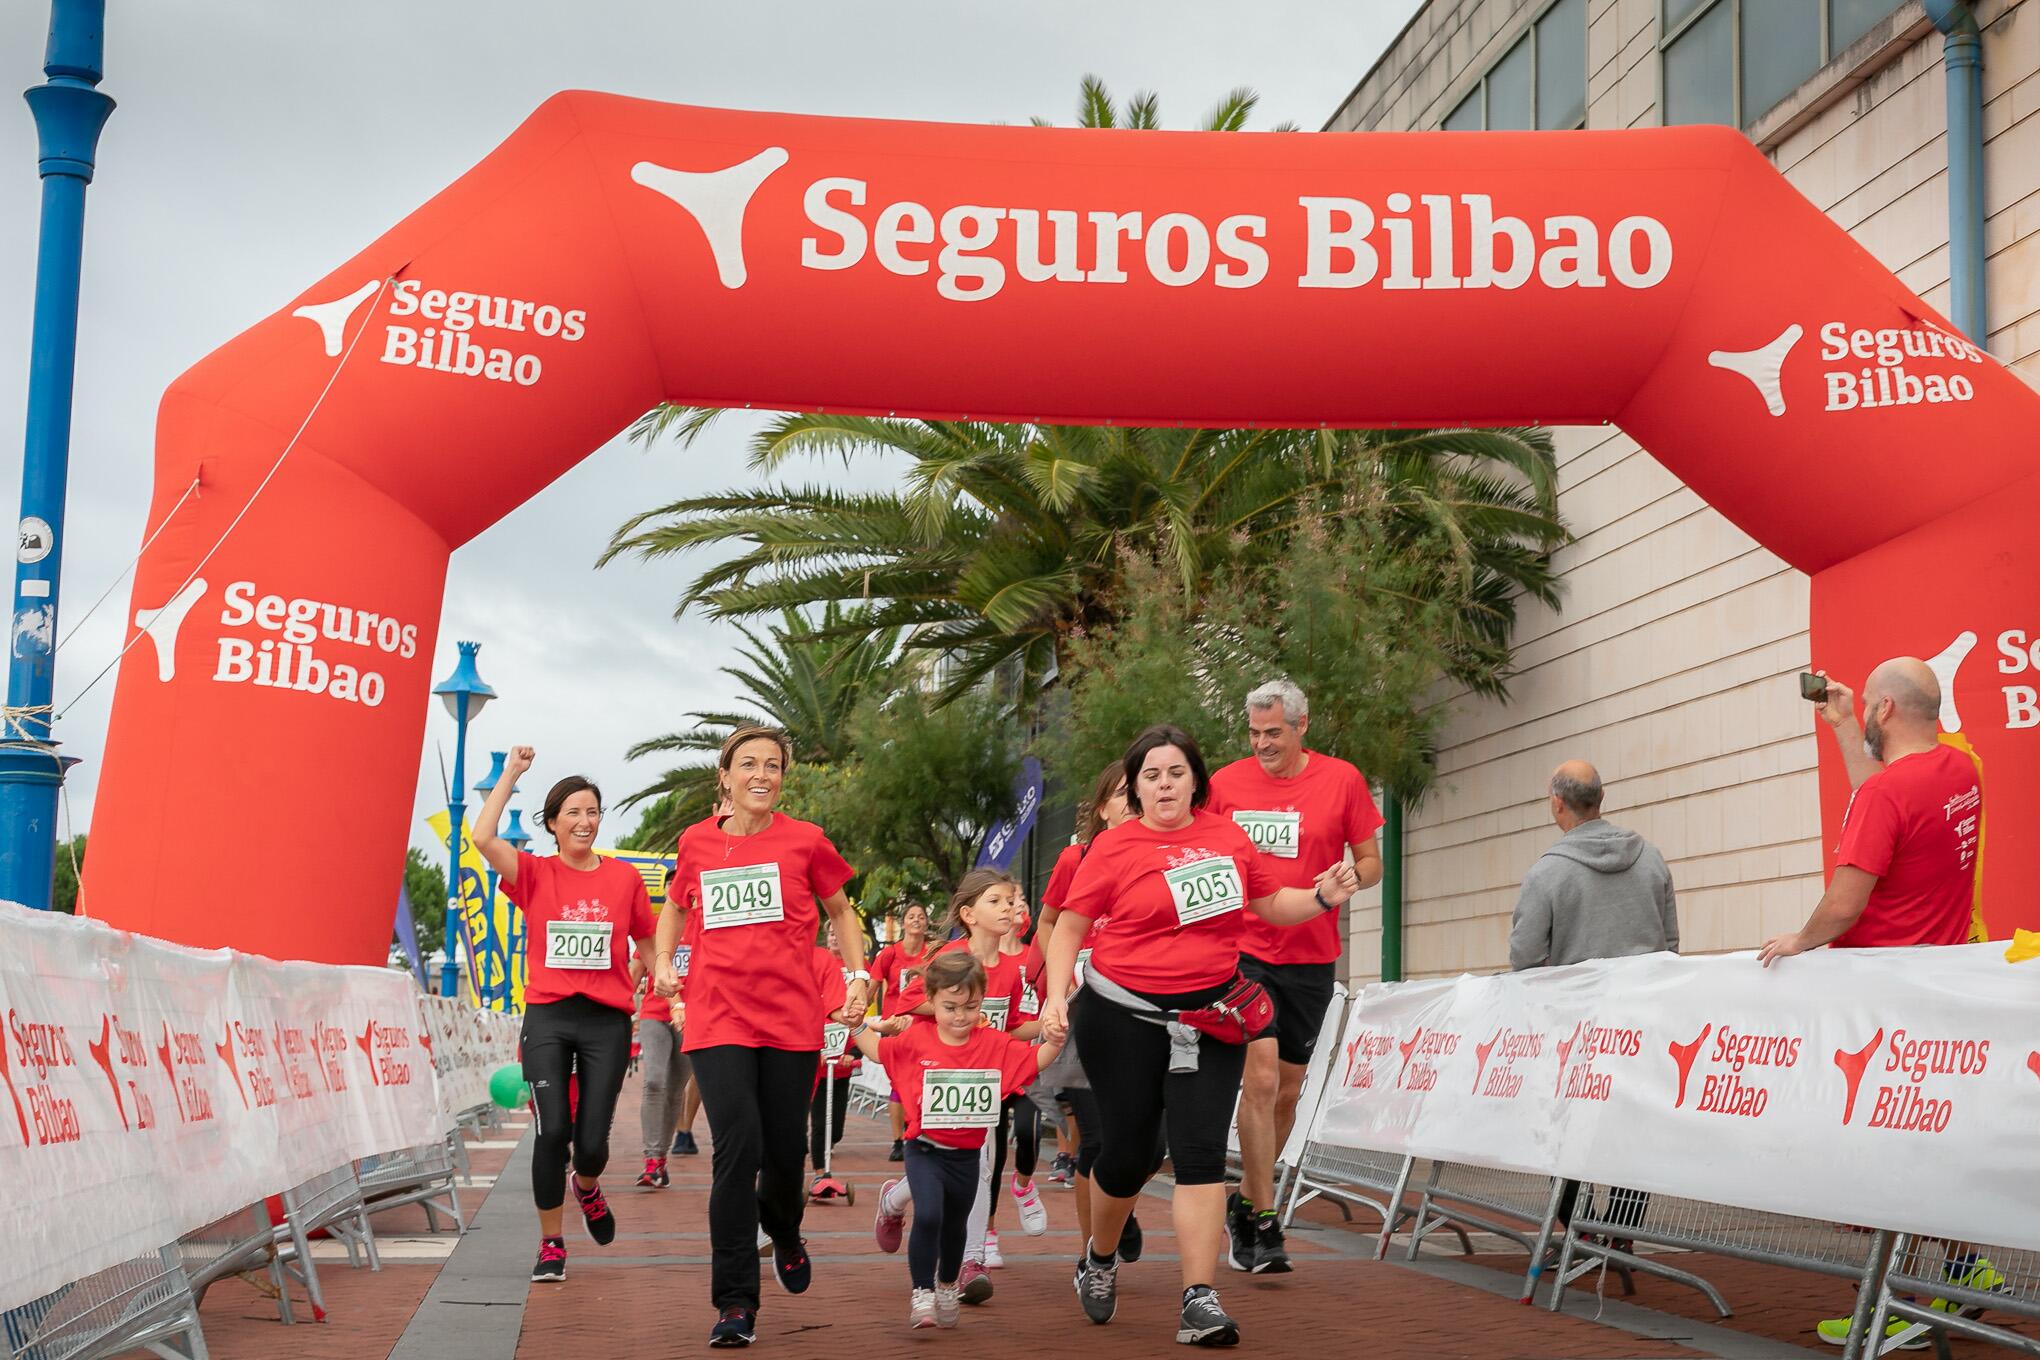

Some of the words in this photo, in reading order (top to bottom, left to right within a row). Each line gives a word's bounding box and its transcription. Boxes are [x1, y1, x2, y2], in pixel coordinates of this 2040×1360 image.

[801, 177, 1270, 302] Seguros
[1297, 192, 1674, 290] Bilbao
[390, 280, 586, 341] Seguros
[380, 325, 542, 386] Bilbao
[1820, 321, 1983, 366] Seguros
[1823, 366, 1974, 411] Bilbao
[221, 581, 418, 659] Seguros
[212, 637, 385, 707] Bilbao
[711, 880, 772, 913] 2049
[1181, 871, 1239, 908] 2051
[554, 934, 605, 958] 2004
[1498, 1027, 1545, 1065] Seguros
[1578, 1020, 1643, 1061] Seguros
[1711, 1024, 1802, 1072] Seguros
[1885, 1029, 1990, 1083] Seguros
[930, 1085, 993, 1113] 2049
[1483, 1065, 1524, 1099] Bilbao
[1565, 1063, 1613, 1101] Bilbao
[1696, 1075, 1769, 1118] Bilbao
[1868, 1086, 1953, 1134] Bilbao
